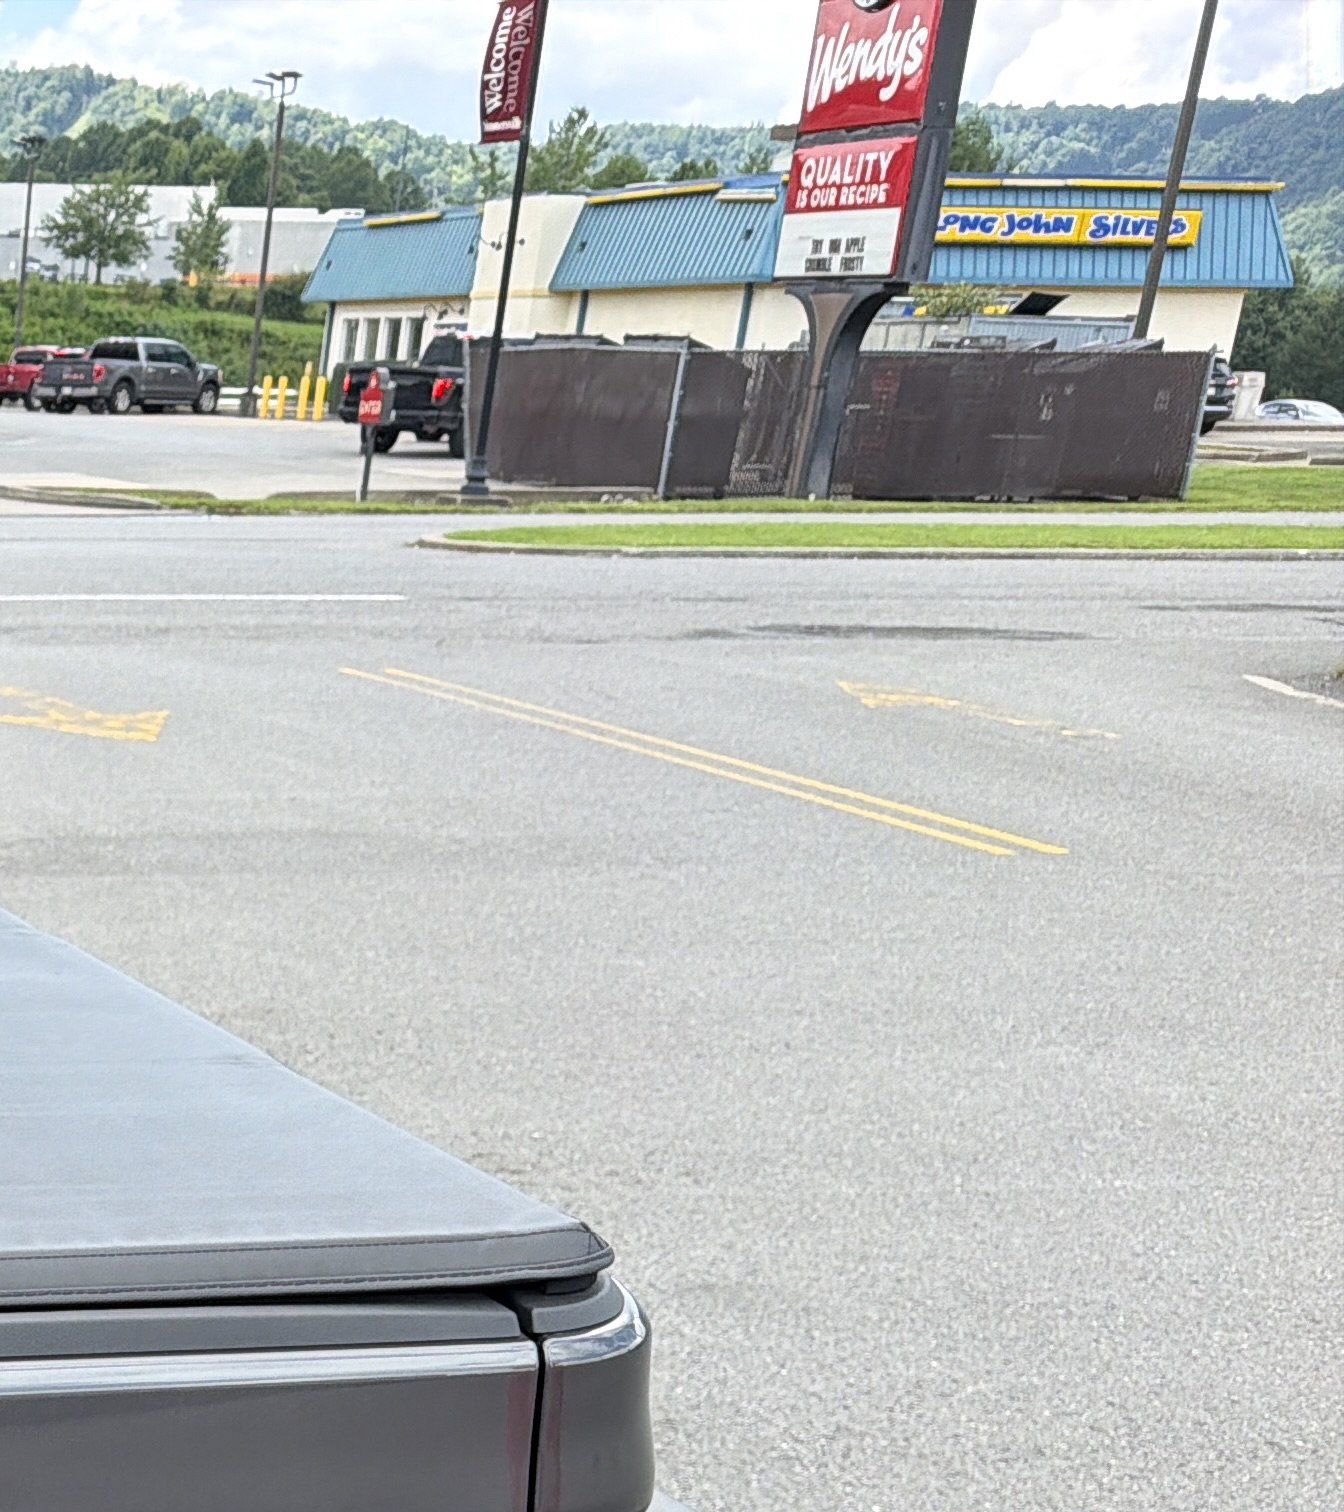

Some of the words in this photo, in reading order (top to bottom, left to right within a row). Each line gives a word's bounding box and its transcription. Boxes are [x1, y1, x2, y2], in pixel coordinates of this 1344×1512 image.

[484, 6, 516, 115] Welcome
[503, 2, 535, 112] Welcome
[807, 3, 928, 112] Wendy's
[800, 150, 895, 189] QUALITY
[795, 188, 809, 208] IS
[810, 186, 837, 207] OUR
[839, 183, 890, 206] RECIPE
[845, 236, 866, 253] APPLE
[839, 256, 865, 273] FROSTY
